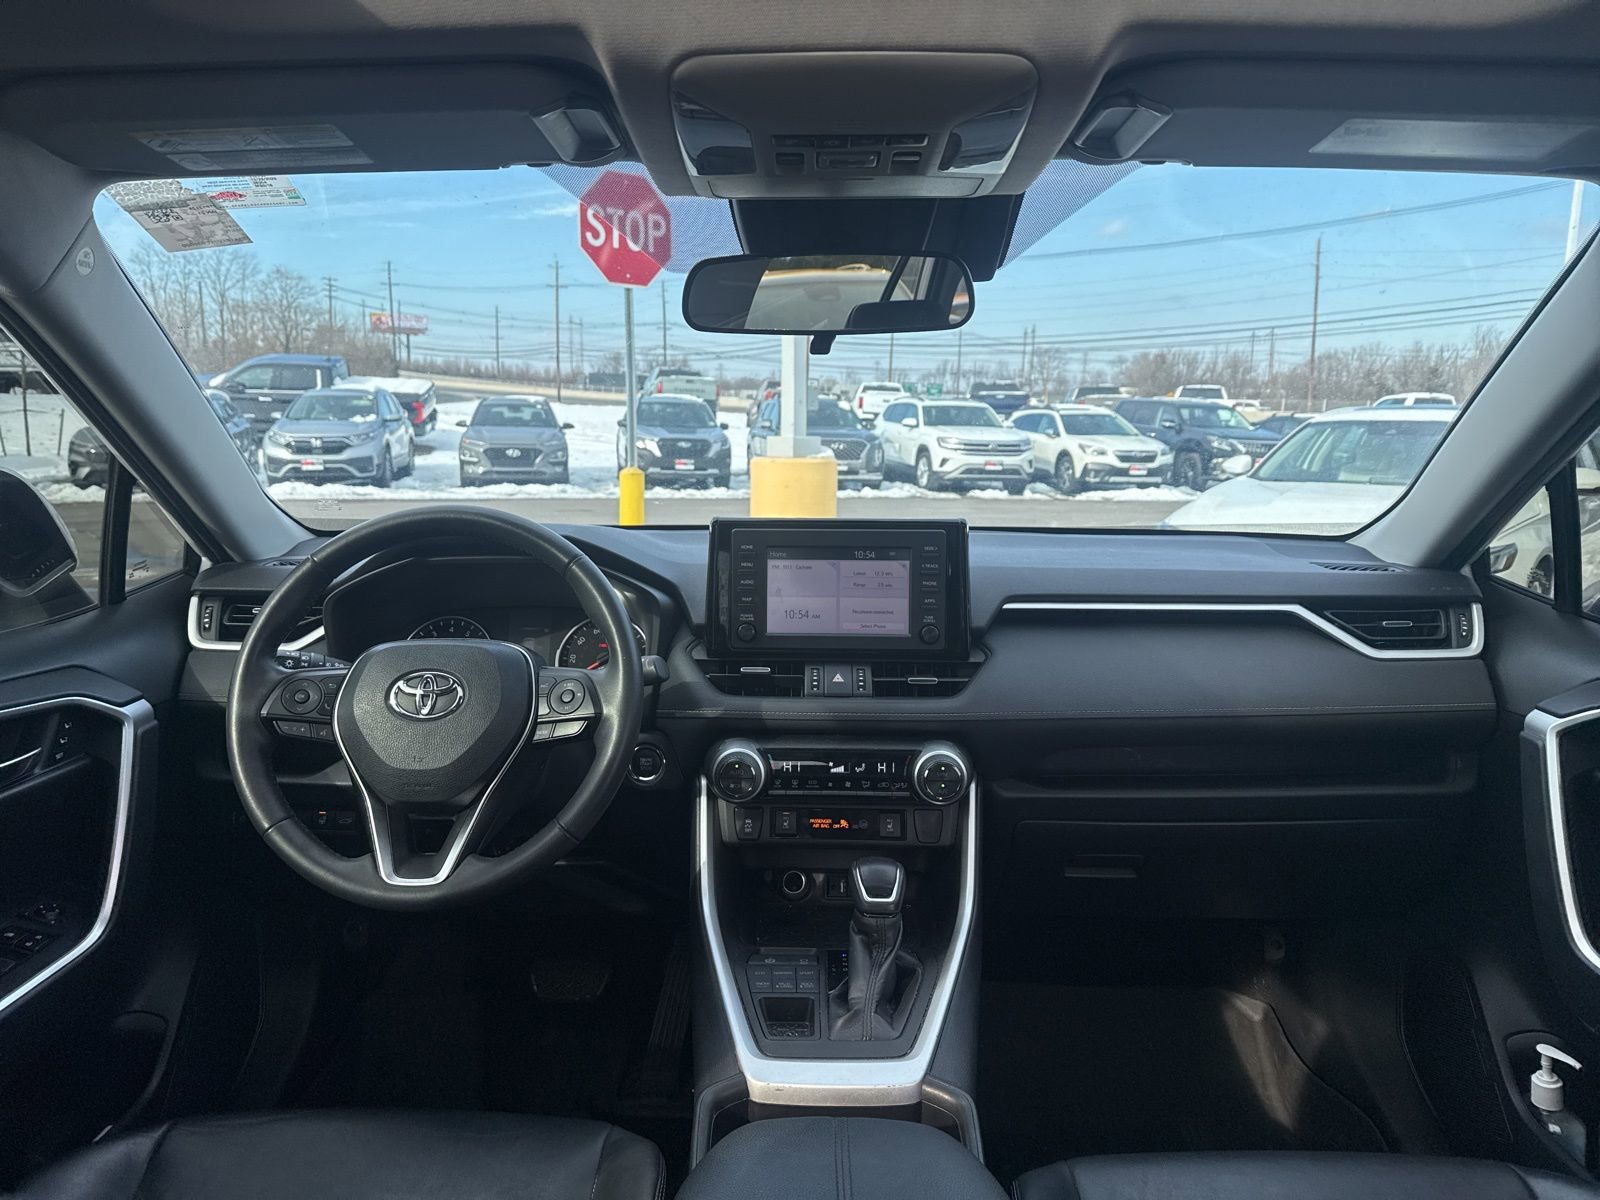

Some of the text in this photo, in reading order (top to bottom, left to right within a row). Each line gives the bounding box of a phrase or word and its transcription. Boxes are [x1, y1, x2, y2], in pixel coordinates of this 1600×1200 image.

[585, 203, 667, 254] STOP
[854, 550, 875, 559] 10:54
[784, 609, 809, 619] 10:54
[577, 636, 586, 646] 40
[569, 654, 577, 664] 20
